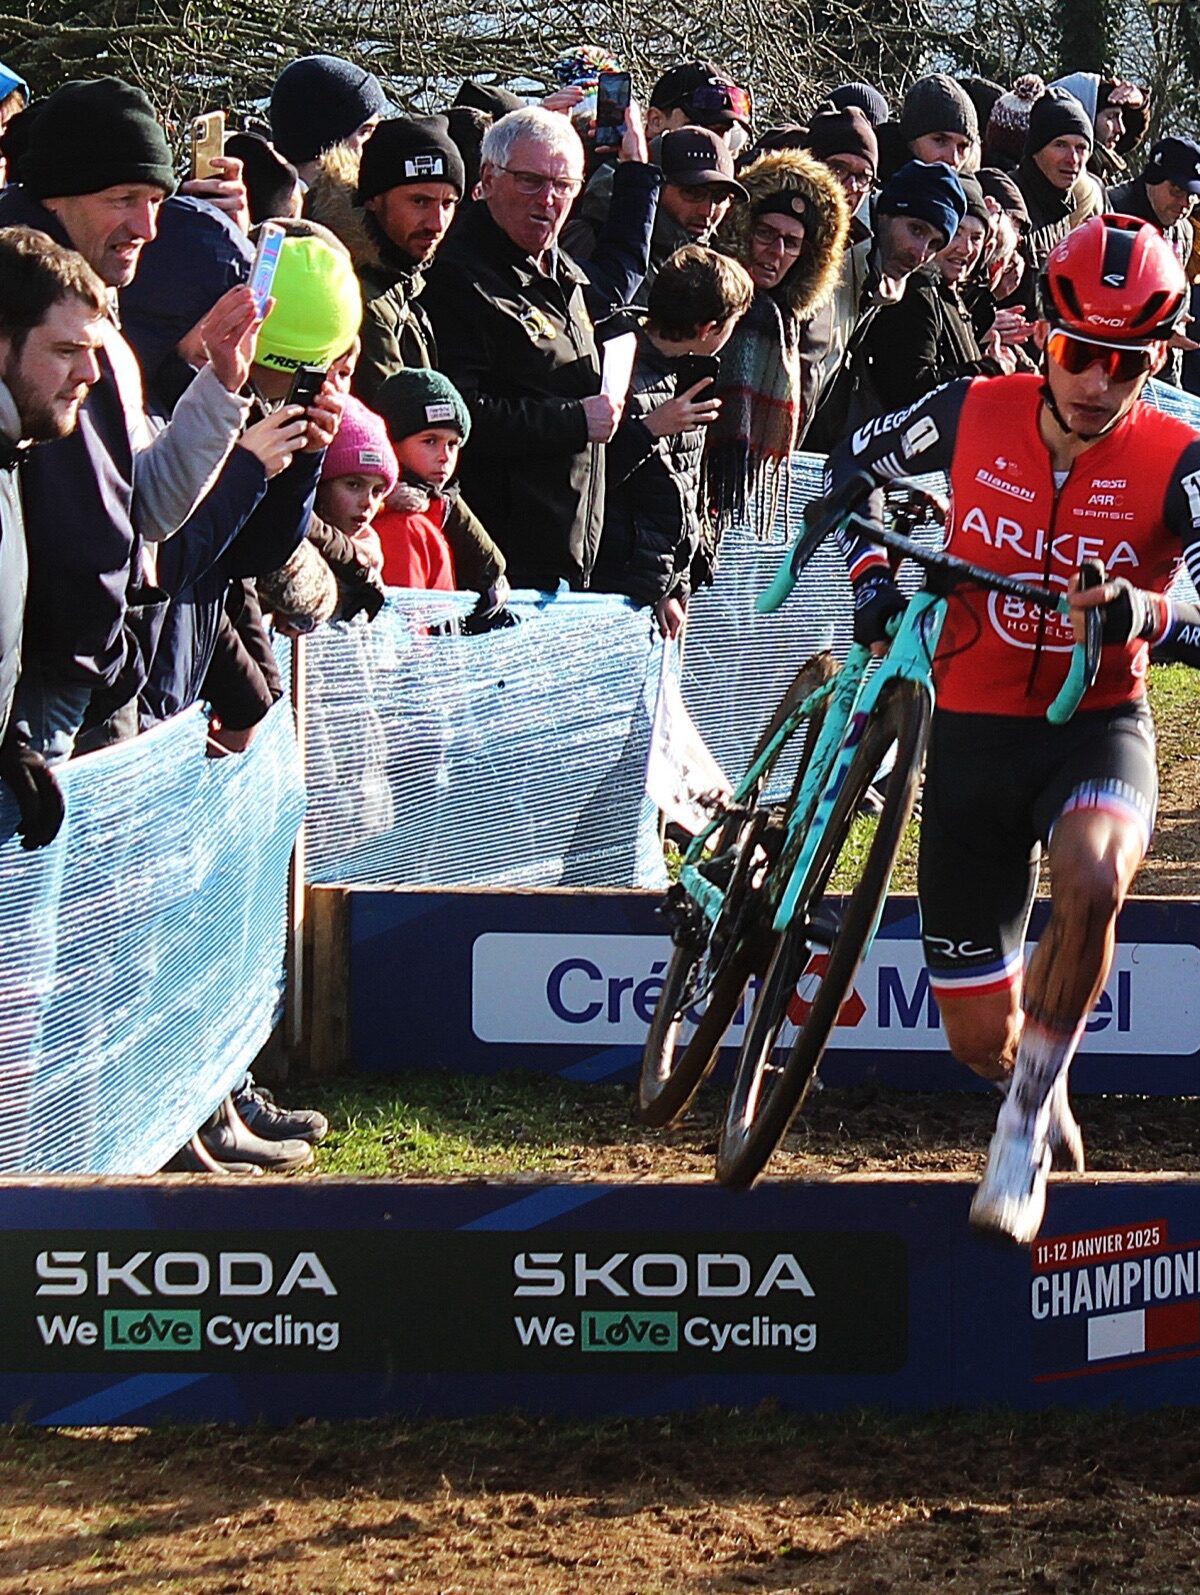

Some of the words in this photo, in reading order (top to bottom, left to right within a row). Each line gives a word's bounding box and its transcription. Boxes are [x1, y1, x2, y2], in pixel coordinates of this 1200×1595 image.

[976, 468, 1036, 500] Bianchi
[1072, 508, 1134, 520] SAMSIC
[1007, 620, 1074, 640] HOTELS
[1037, 1242, 1068, 1265] 11-12
[1071, 1236, 1123, 1260] JANVIER
[1126, 1227, 1160, 1250] 2025
[36, 1251, 338, 1296] SKODA
[513, 1253, 816, 1297] SKODA
[36, 1315, 98, 1345] We
[206, 1315, 340, 1351] Cycling
[514, 1316, 575, 1346] We
[684, 1316, 817, 1351] Cycling
